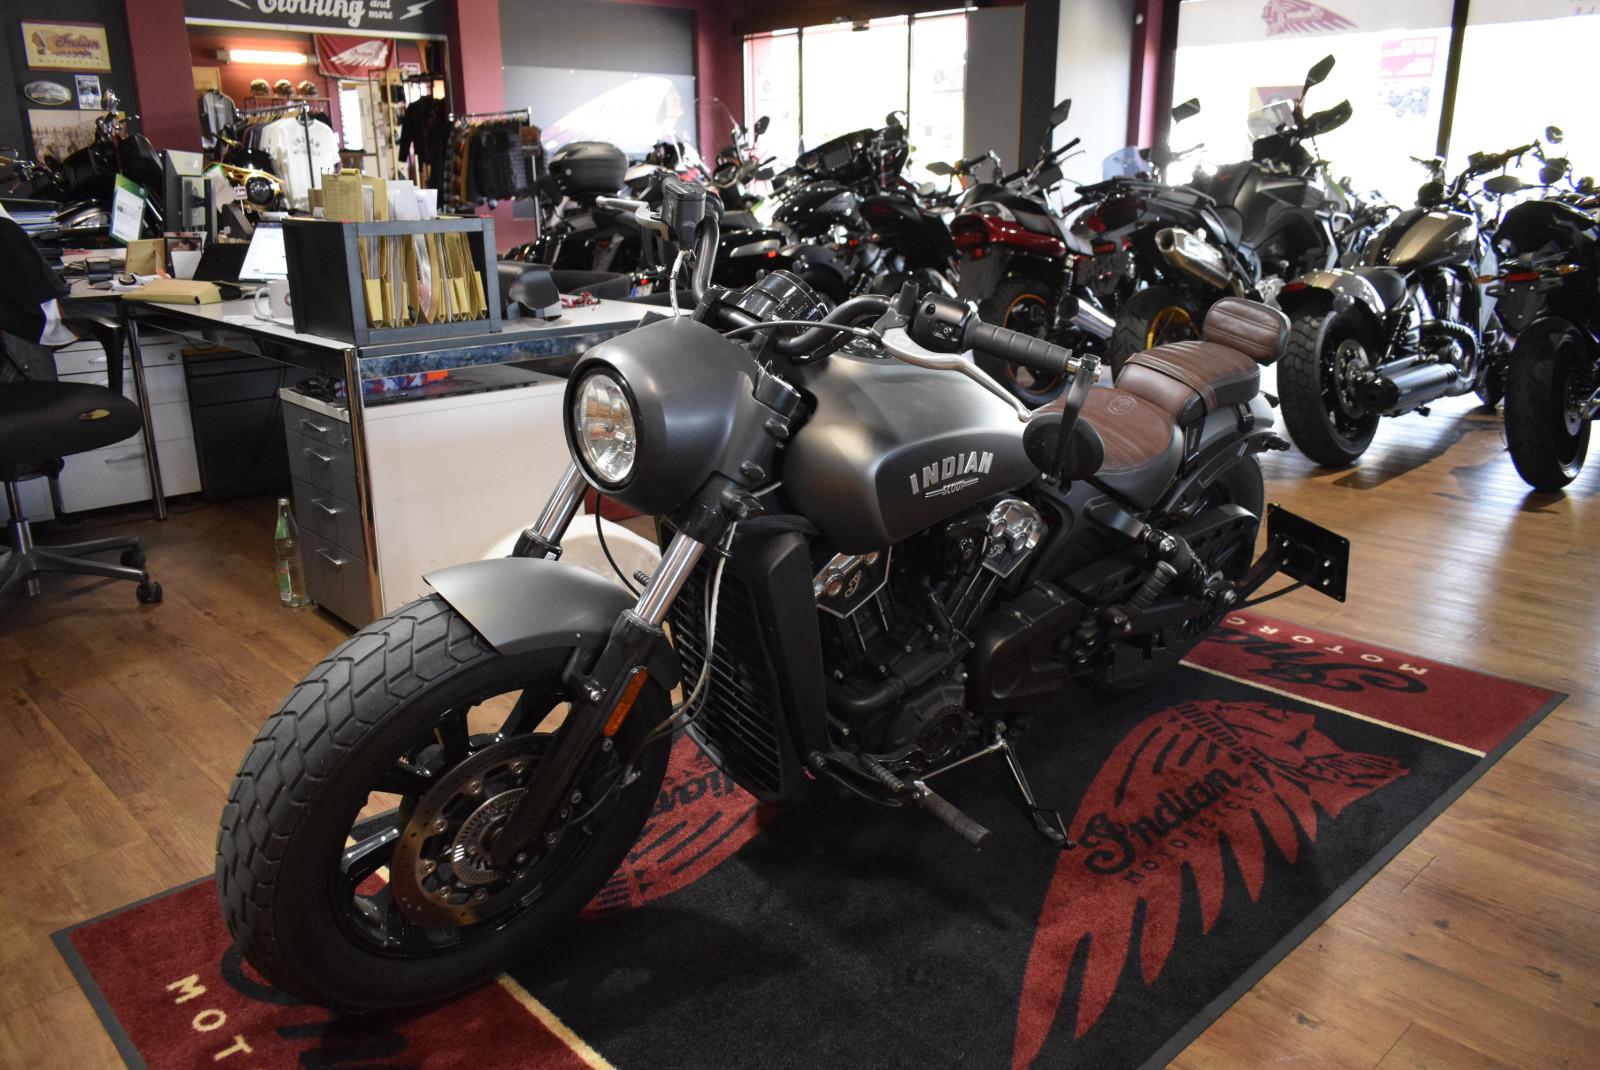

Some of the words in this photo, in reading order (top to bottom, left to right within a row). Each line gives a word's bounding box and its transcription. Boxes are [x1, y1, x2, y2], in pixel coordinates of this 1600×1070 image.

[368, 10, 393, 19] more
[910, 451, 994, 495] INDIAN
[943, 479, 965, 495] SCOUT
[1078, 768, 1243, 875] Indian
[1122, 784, 1264, 885] MOTORCYCLE
